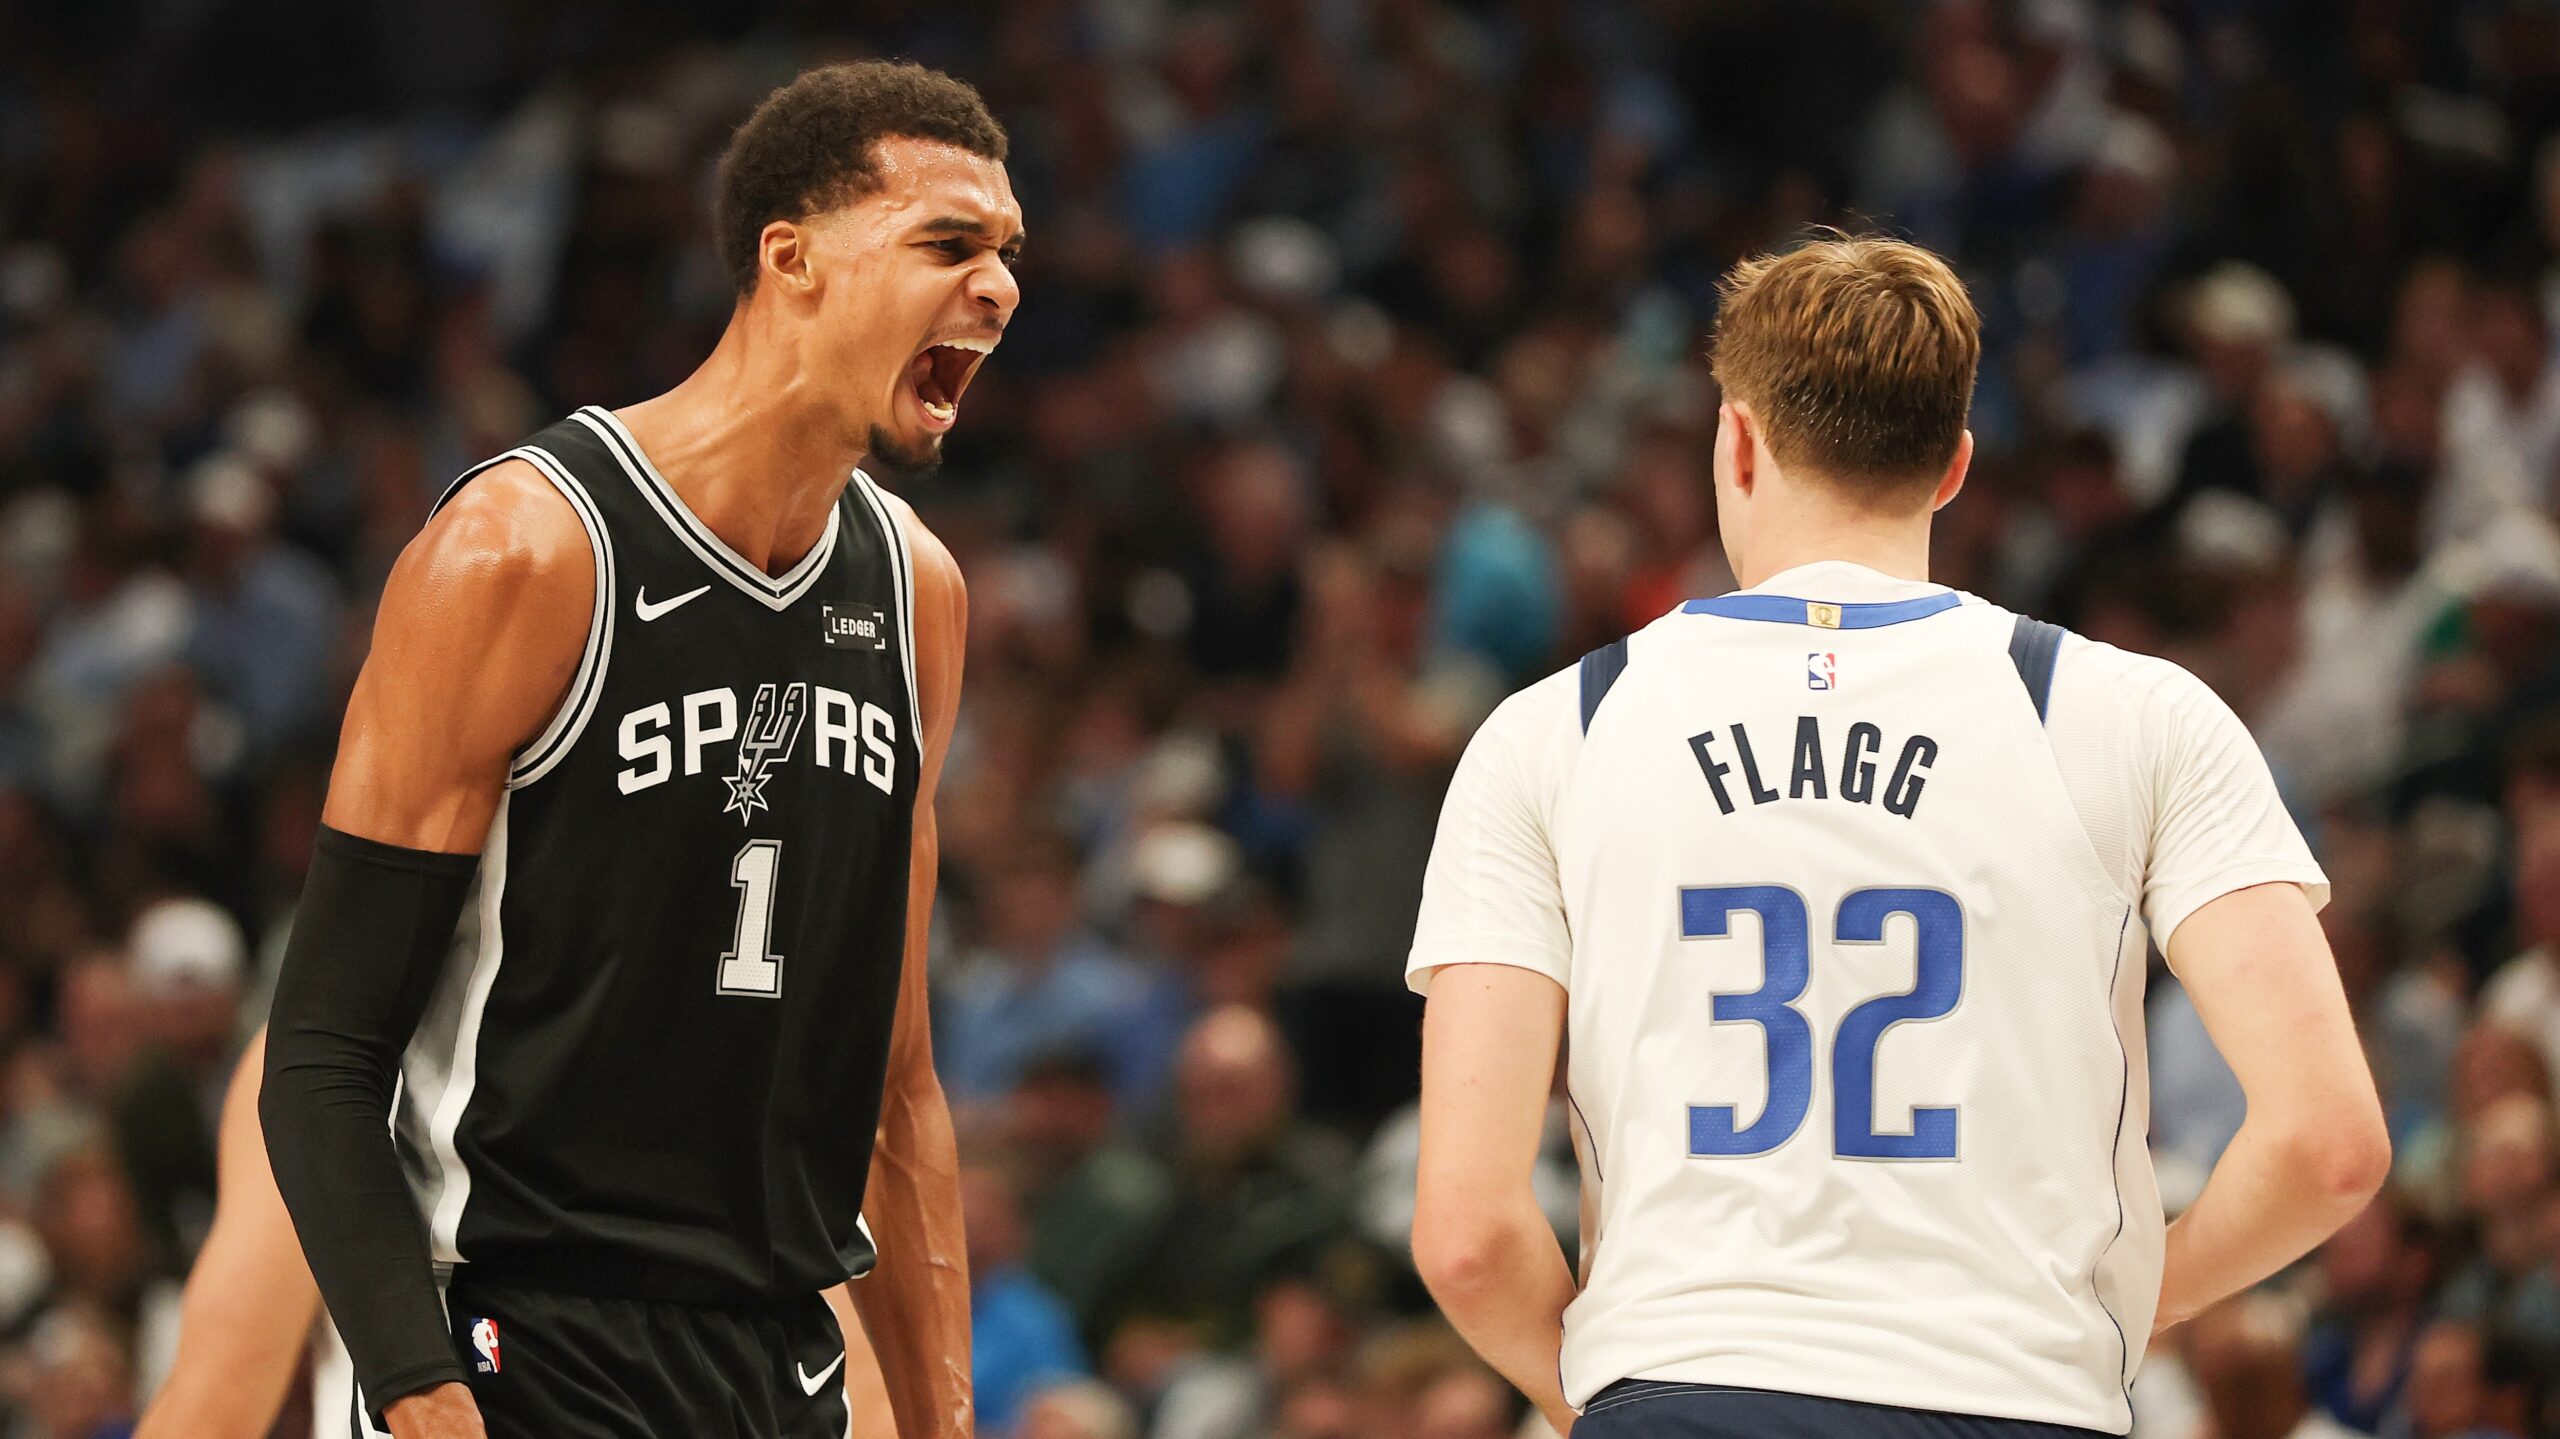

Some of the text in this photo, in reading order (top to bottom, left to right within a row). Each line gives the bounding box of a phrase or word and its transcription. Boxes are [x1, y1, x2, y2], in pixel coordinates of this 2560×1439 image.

[832, 615, 876, 638] LEDGER
[617, 682, 896, 827] SPURS
[1687, 715, 1938, 819] FLAGG
[716, 838, 784, 998] 1
[1677, 881, 1968, 1163] 32
